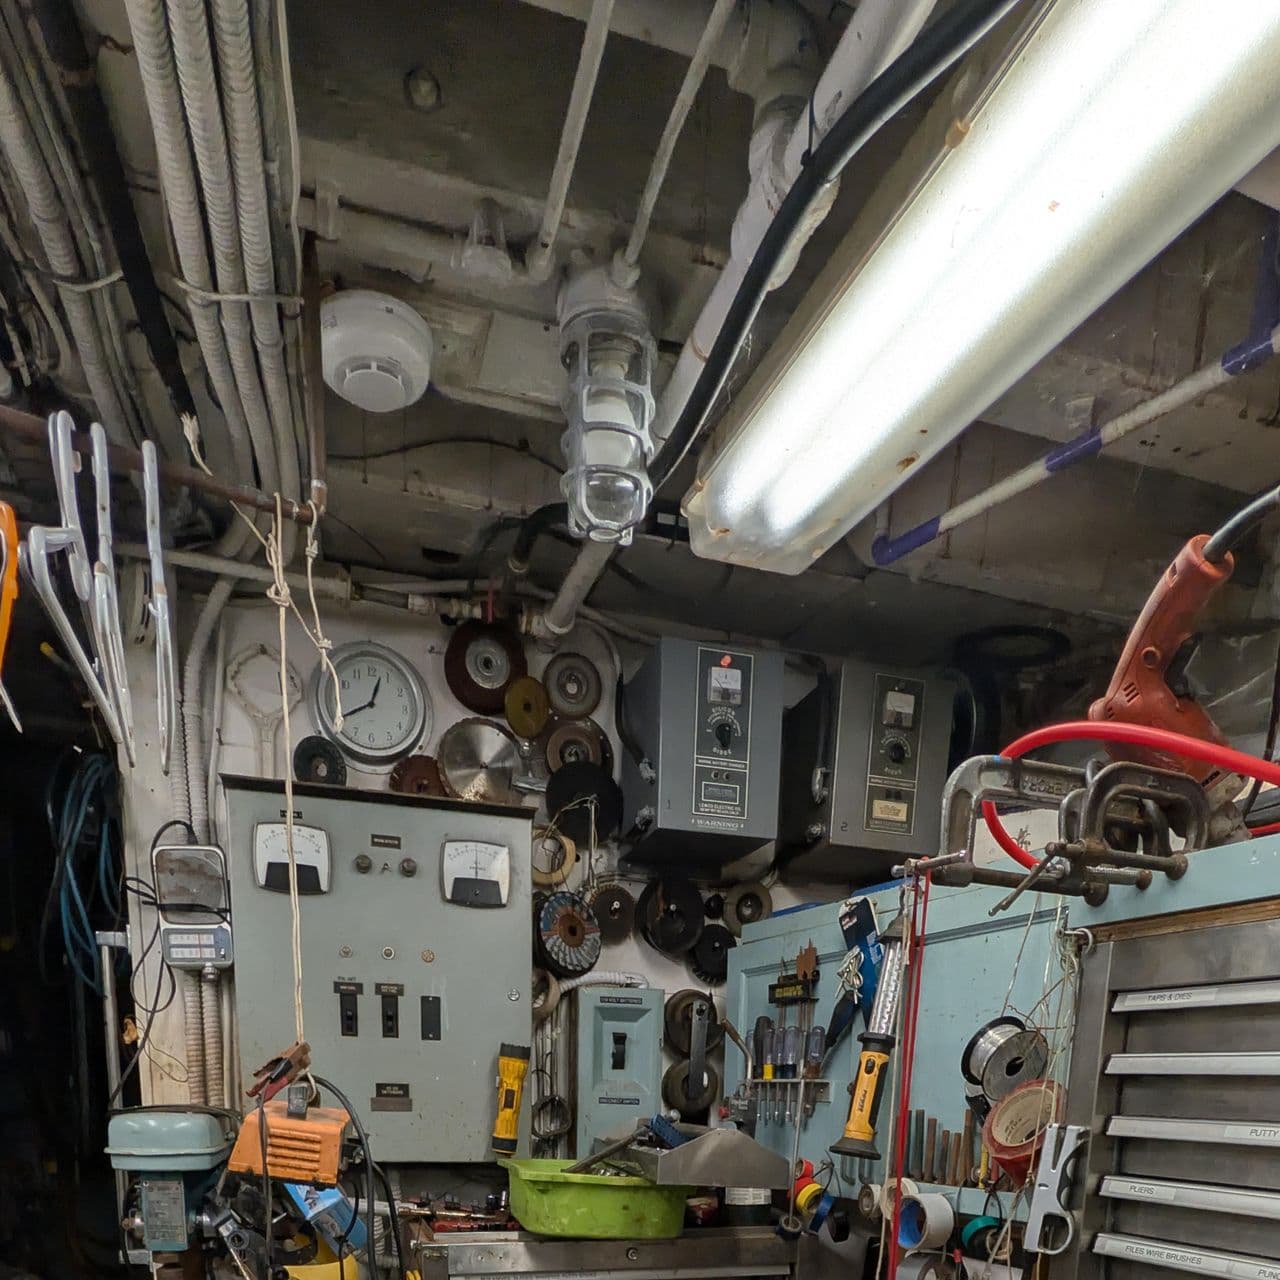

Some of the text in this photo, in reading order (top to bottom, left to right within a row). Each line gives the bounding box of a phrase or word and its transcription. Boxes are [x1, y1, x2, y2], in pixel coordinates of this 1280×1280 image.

[367, 666, 377, 677] 12
[697, 818, 739, 829] WARNING
[1147, 993, 1166, 1001] TAPS
[1173, 991, 1193, 1000] DIES
[1249, 1128, 1279, 1138] PUTTY
[1128, 1185, 1155, 1195] PLIERS
[1124, 1245, 1202, 1266] FILES WIRE BRUSHES
